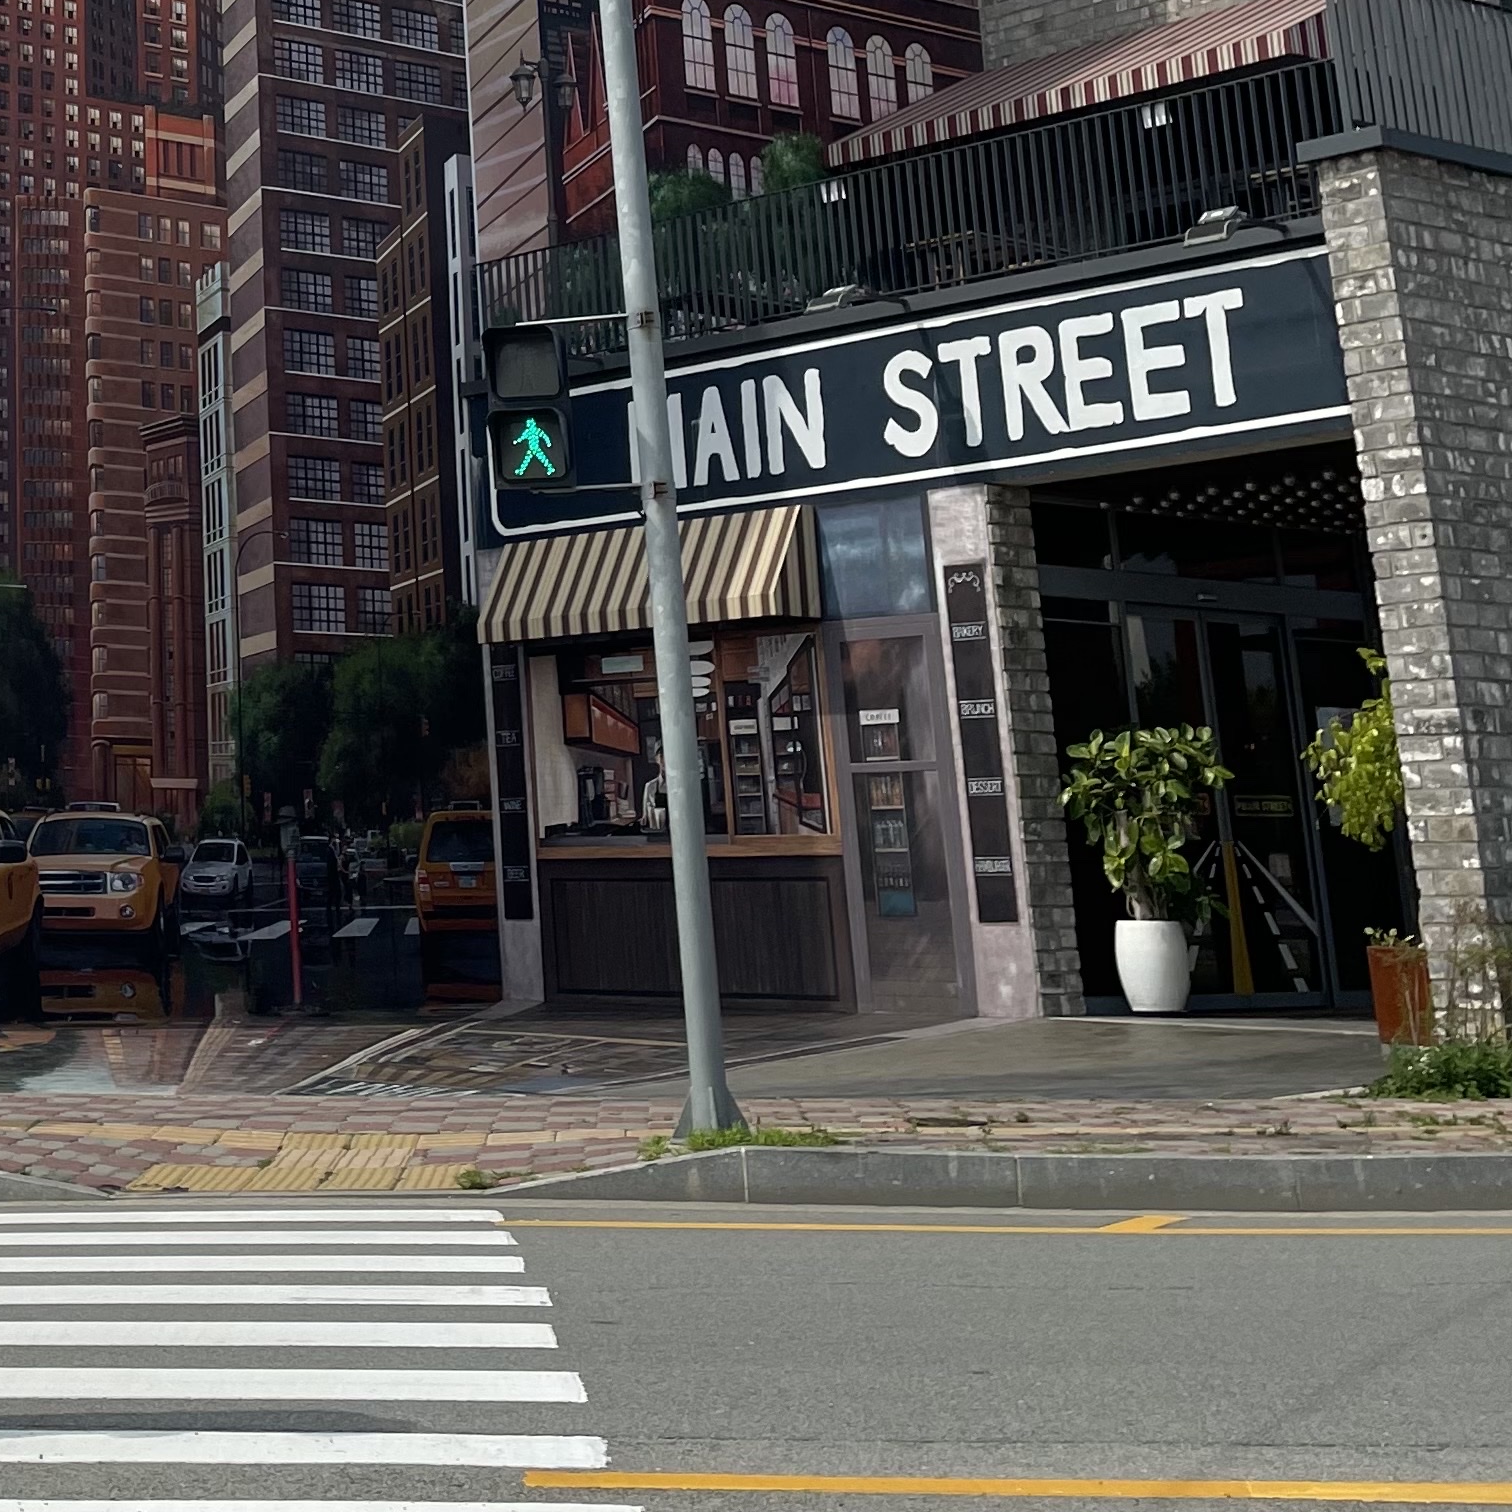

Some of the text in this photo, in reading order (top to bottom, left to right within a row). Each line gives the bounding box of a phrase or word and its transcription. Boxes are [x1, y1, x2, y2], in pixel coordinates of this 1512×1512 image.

[883, 287, 1244, 458] STREET
[952, 625, 983, 638] BAKERY
[960, 703, 995, 715] BRUNCH
[501, 733, 517, 744] TEA
